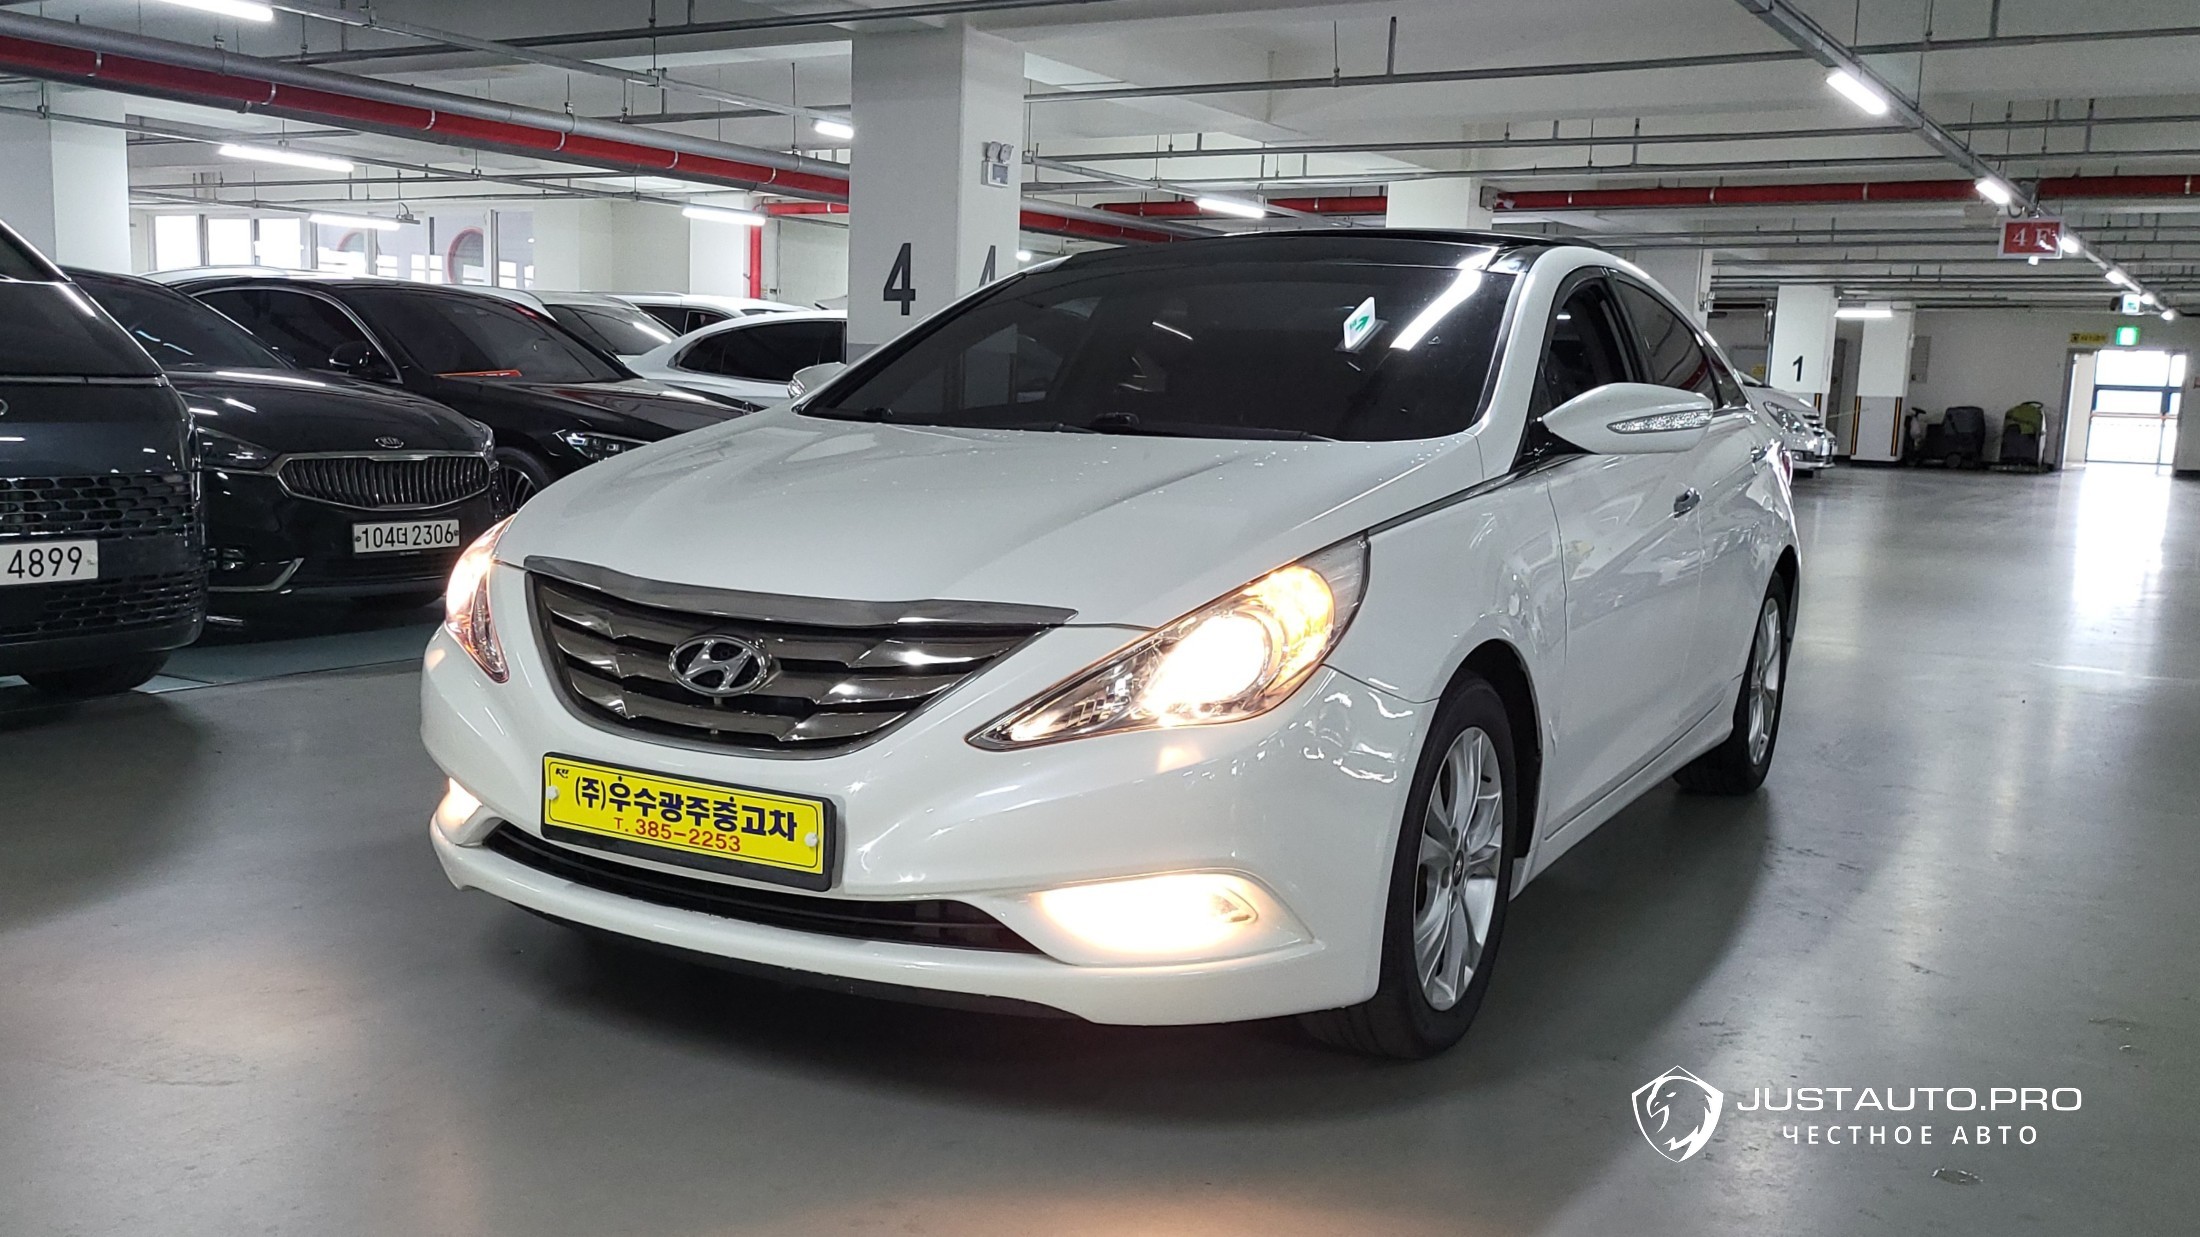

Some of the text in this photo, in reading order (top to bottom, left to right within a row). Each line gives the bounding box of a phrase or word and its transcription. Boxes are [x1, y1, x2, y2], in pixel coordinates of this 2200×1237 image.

[2012, 227, 2026, 247] 4
[883, 242, 916, 316] 4
[1792, 355, 1804, 382] 1
[7, 546, 83, 579] 4899
[575, 775, 798, 842] (주)우수광주중고차
[635, 818, 741, 852] 385-2253
